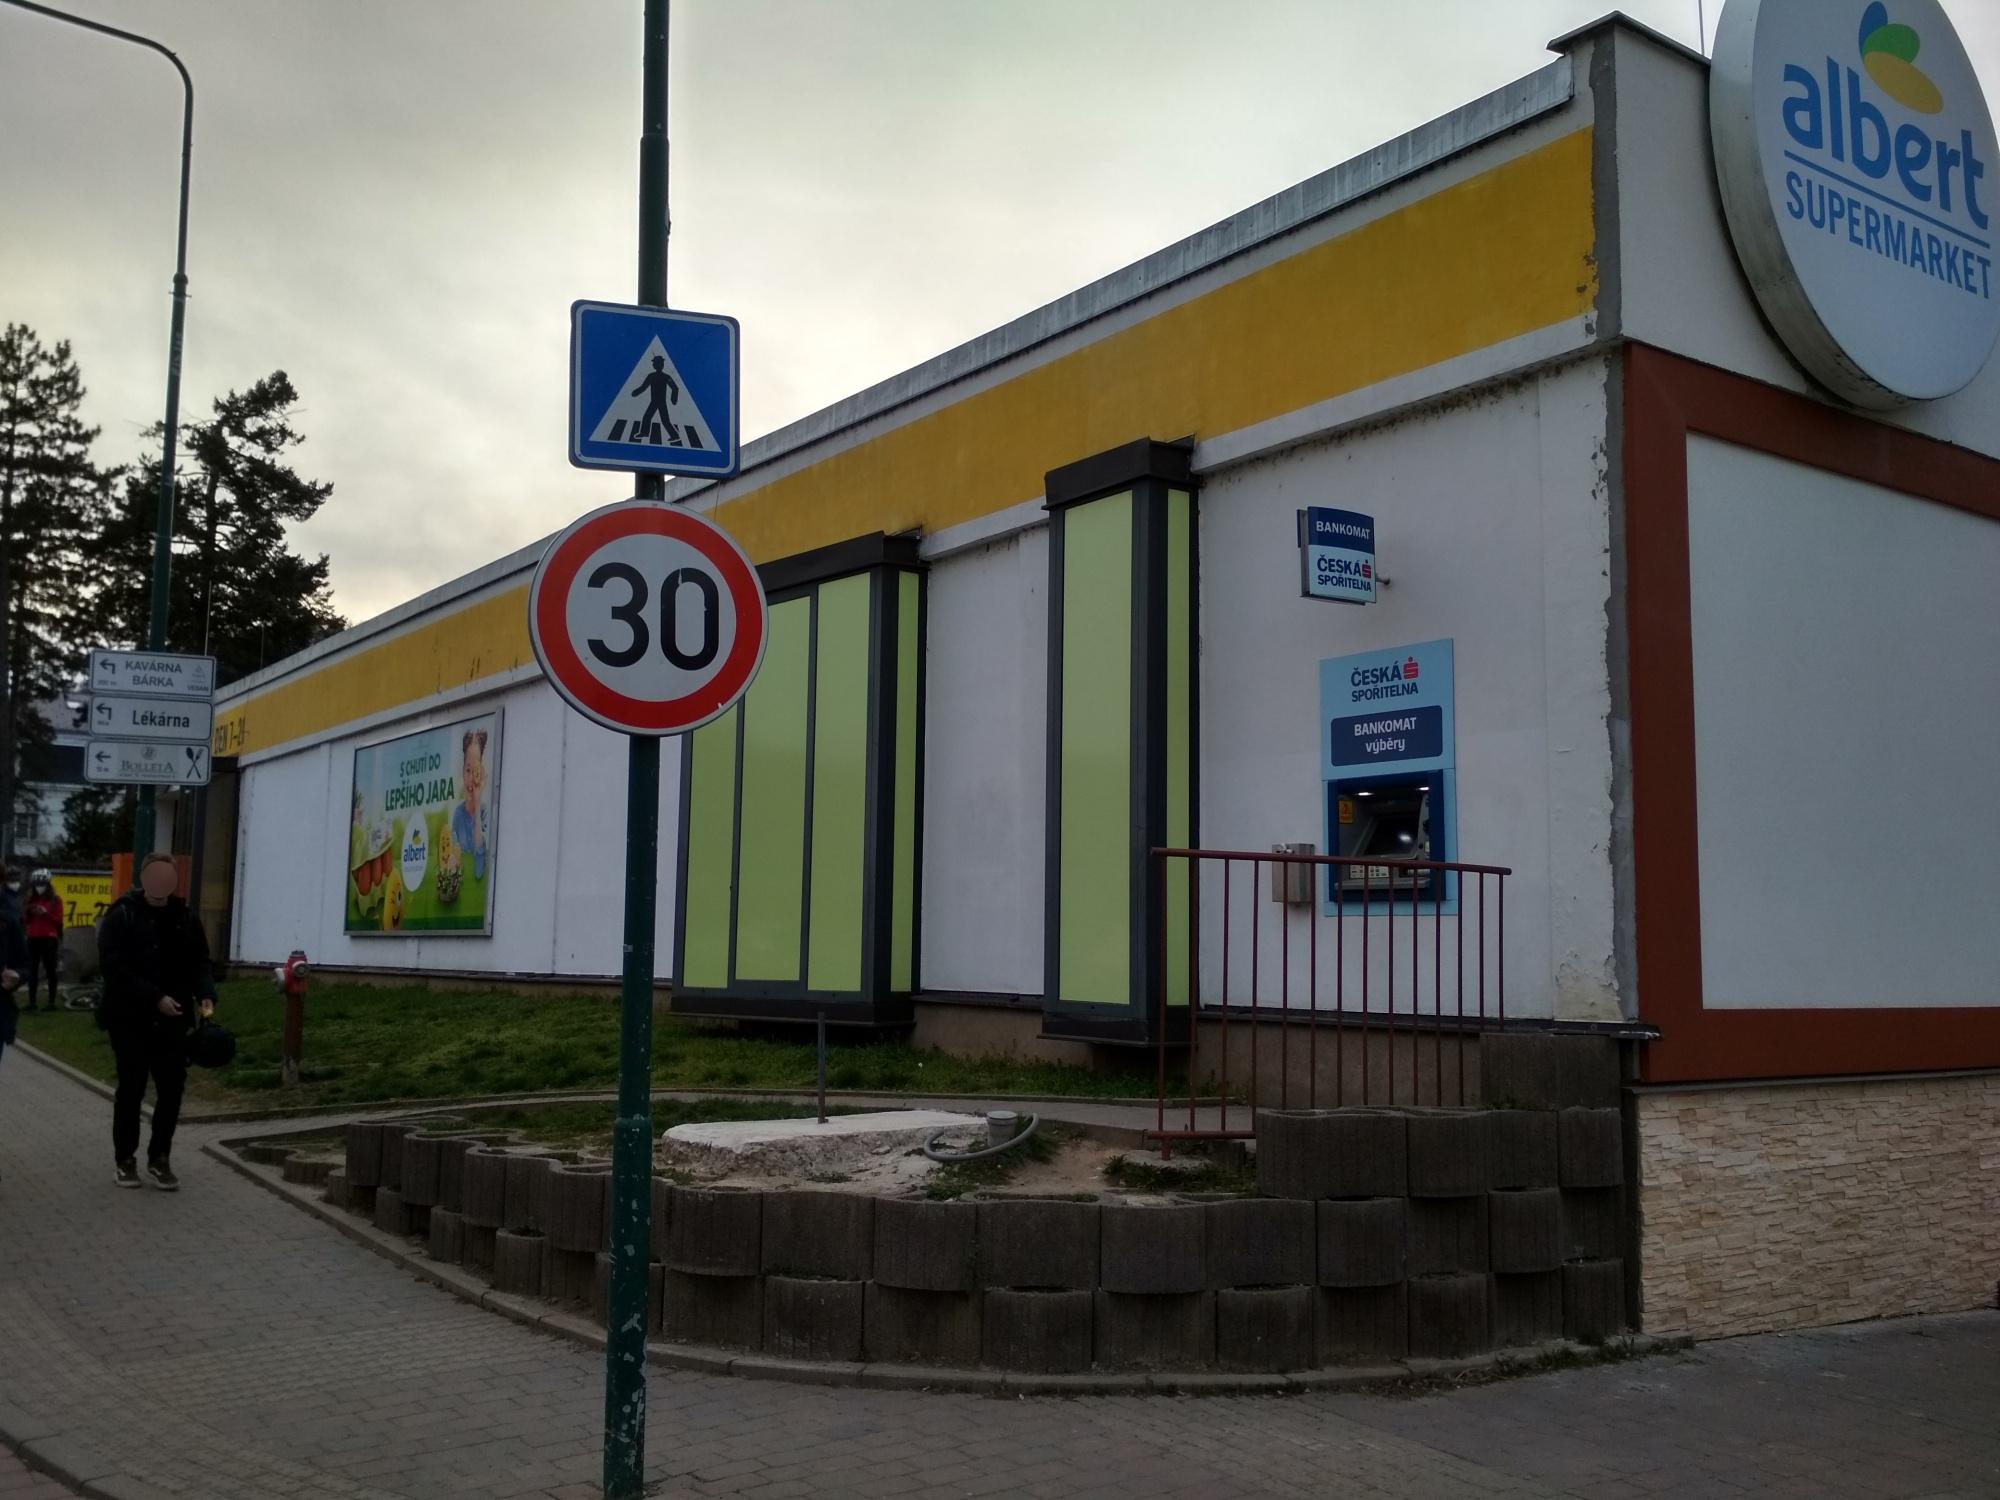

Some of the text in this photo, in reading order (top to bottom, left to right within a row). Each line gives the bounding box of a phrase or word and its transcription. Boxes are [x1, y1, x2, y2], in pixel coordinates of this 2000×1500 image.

[1782, 56, 1989, 230] albert
[1785, 170, 1991, 299] SUPERMARKET
[1316, 520, 1371, 539] BANKOMAT
[1317, 554, 1361, 577] ČESKÁ
[1317, 574, 1372, 592] SPOŘITELNA
[587, 562, 719, 671] 30
[125, 660, 182, 673] KAVÁRNA
[1350, 660, 1402, 687] ČESKÁ
[132, 674, 174, 687] BÁRKA
[1351, 682, 1418, 702] SPOŘITELNA
[132, 710, 190, 728] Lékárna
[1354, 717, 1417, 736] BANKOMAT
[1365, 738, 1405, 754] výběry
[400, 752, 441, 777] S CHUTÍ DO
[385, 777, 455, 811] LEPŠÍHO JARA
[403, 842, 426, 862] albert
[98, 884, 112, 895] DE
